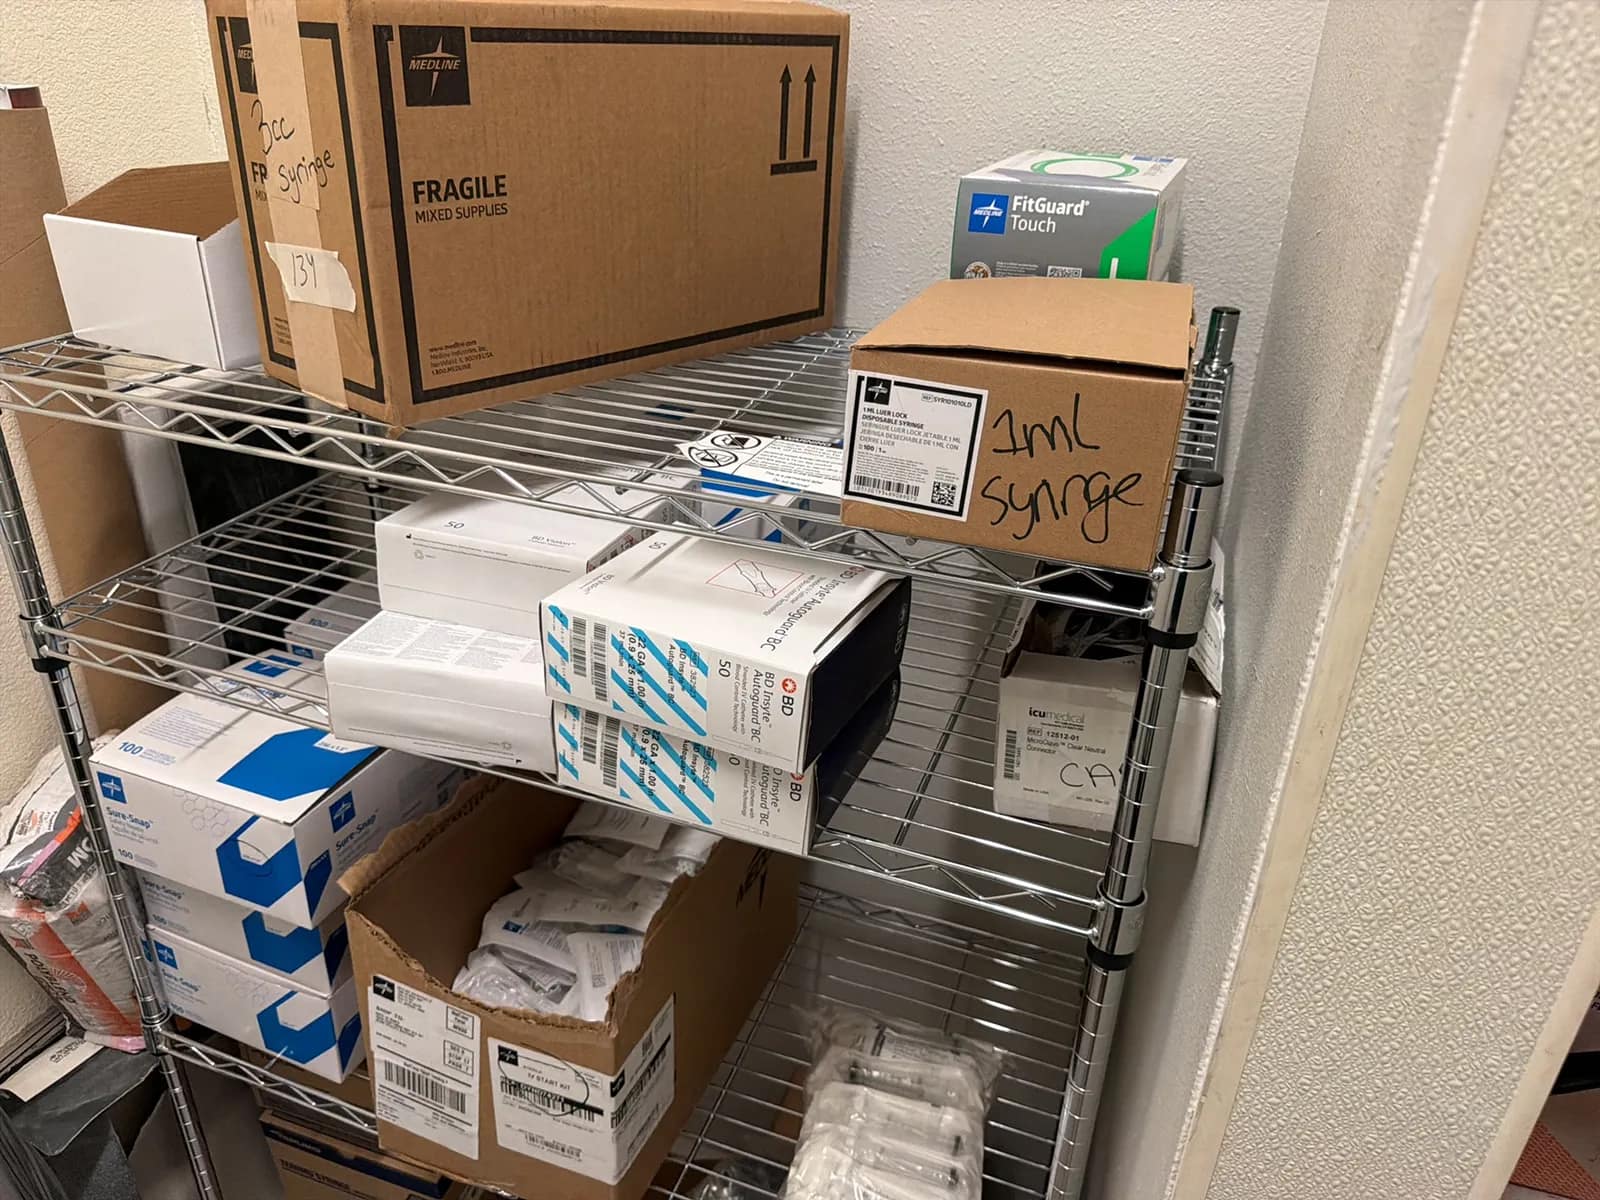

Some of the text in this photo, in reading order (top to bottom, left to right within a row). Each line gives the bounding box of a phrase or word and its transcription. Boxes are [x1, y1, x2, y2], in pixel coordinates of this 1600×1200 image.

[409, 59, 461, 71] MEDLINE
[251, 99, 295, 155] 3cc
[413, 175, 507, 204] FRAGILE
[415, 203, 508, 224] MIXED SUPPLIES
[1011, 214, 1056, 233] Touch
[862, 414, 924, 430] DISPOSABLE SYRINGE
[892, 411, 908, 419] LOCK
[444, 521, 465, 529] 50
[639, 636, 647, 649] 22
[760, 635, 783, 651] BC
[637, 651, 646, 666] GA
[680, 648, 687, 660] BD
[628, 663, 636, 676] 25
[719, 659, 731, 678] 50
[764, 671, 775, 688] BD
[637, 678, 646, 698] 1.00
[668, 693, 676, 705] BC
[781, 695, 795, 717] BD
[751, 728, 760, 743] BC
[1046, 731, 1080, 741] 12512-01
[119, 742, 144, 755] 100
[650, 743, 659, 757] GA
[639, 754, 648, 766] 25
[648, 768, 657, 787] 1.00
[790, 782, 802, 802] BD
[760, 811, 769, 827] BC
[118, 848, 134, 860] 100
[536, 1074, 558, 1087] START
